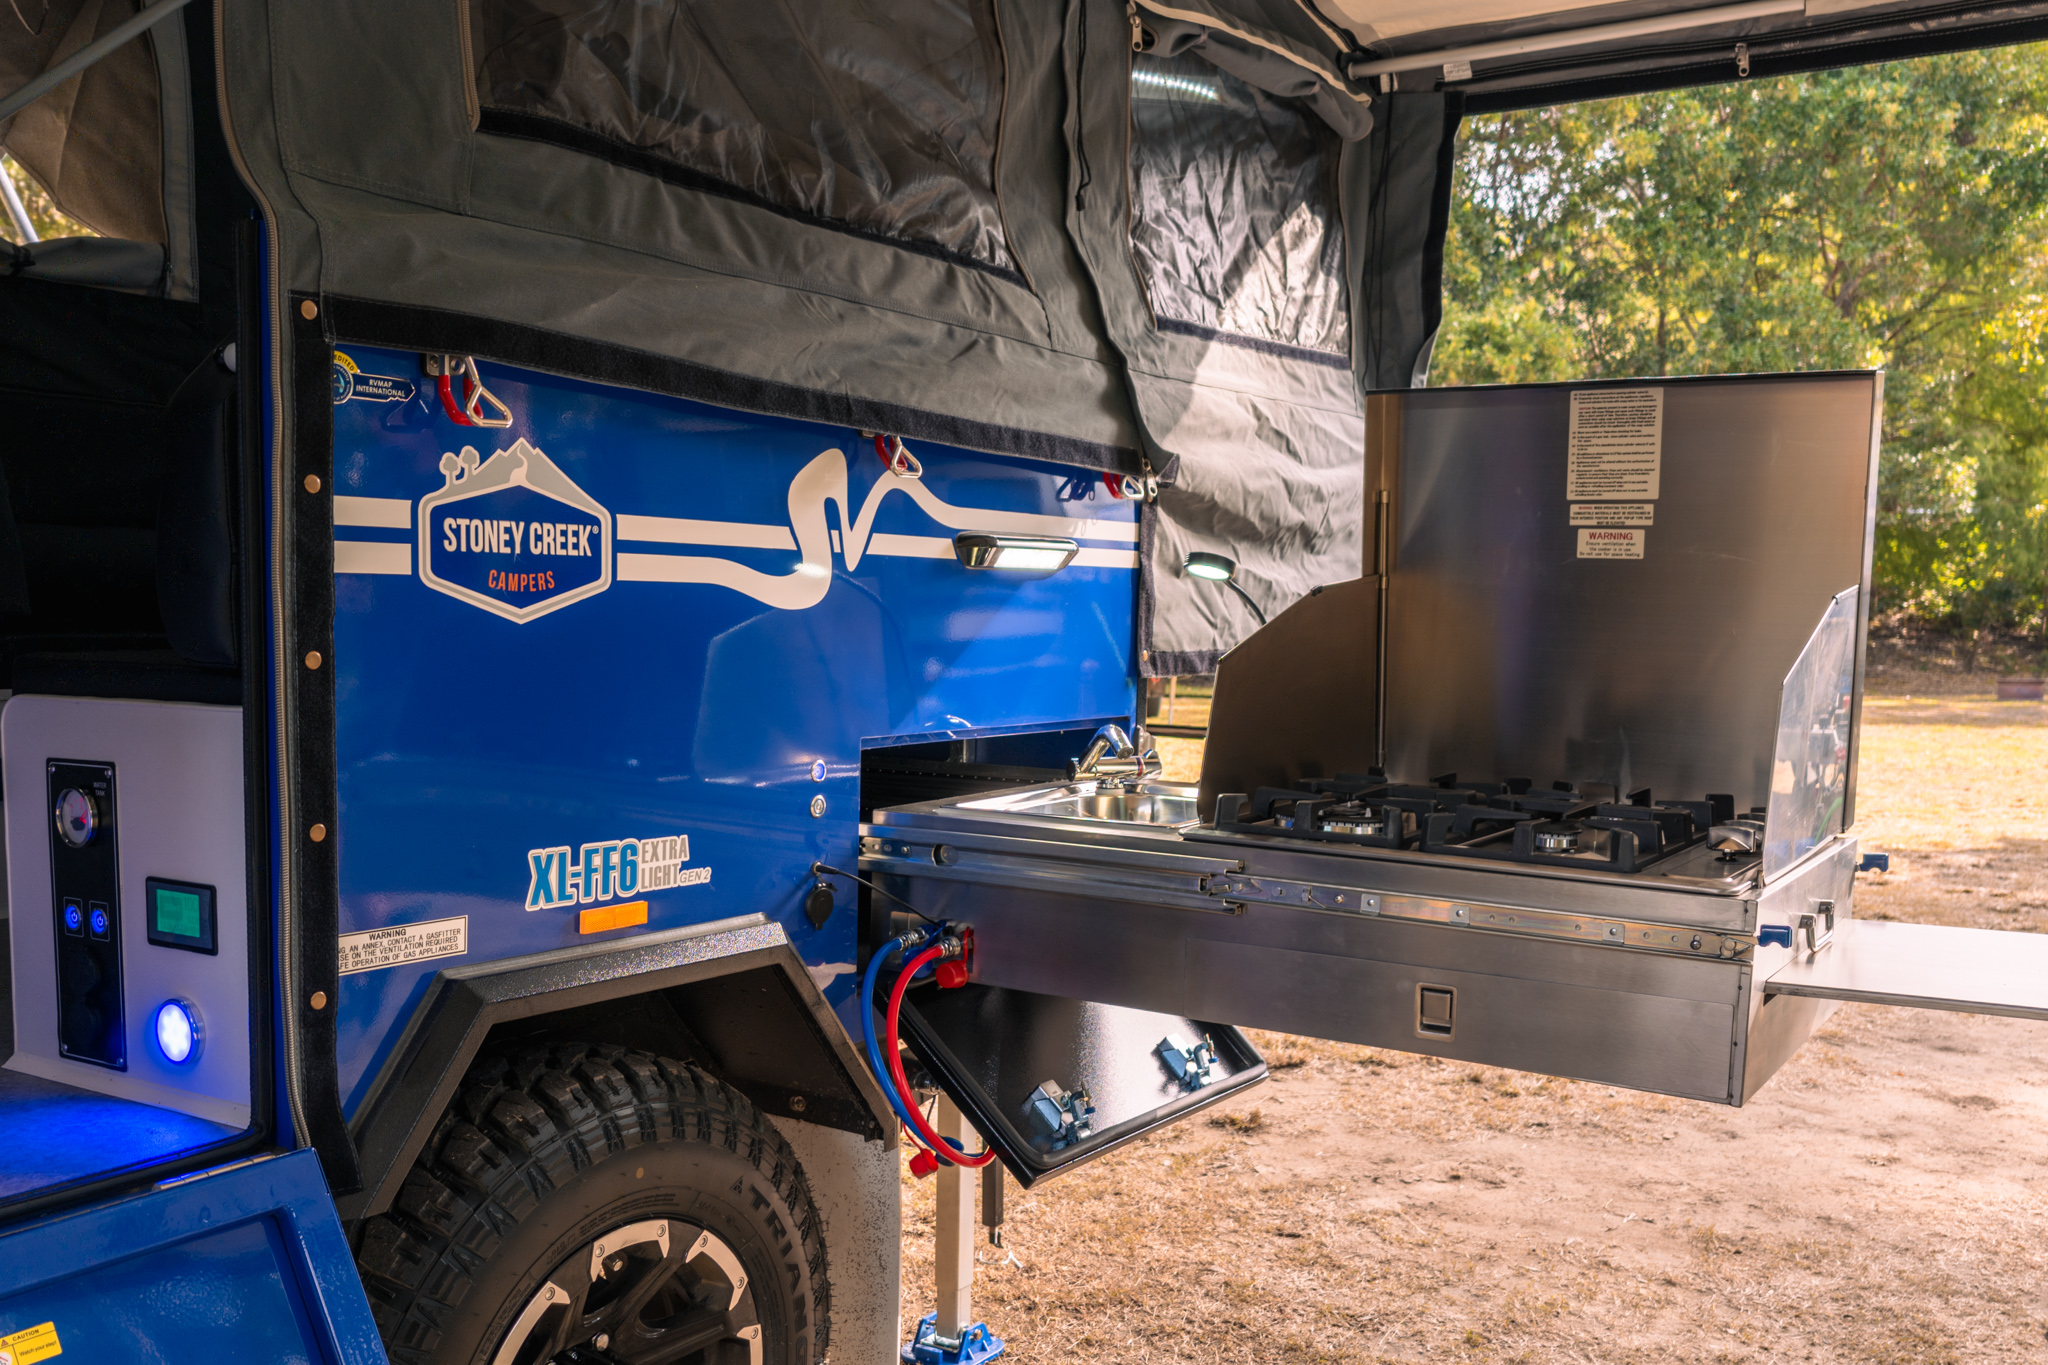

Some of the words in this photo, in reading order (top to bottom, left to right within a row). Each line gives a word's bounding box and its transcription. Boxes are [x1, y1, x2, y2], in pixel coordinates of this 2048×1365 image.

[356, 384, 406, 397] INTERNATIONAL
[368, 379, 393, 388] RVMAP
[443, 517, 525, 554] STONEY
[1589, 532, 1633, 540] WARNING
[488, 569, 555, 592] CAMPERS
[642, 837, 688, 864] EXTRA
[528, 841, 640, 908] XL-FF6
[641, 863, 680, 890] LIGHT
[680, 870, 702, 884] GEN
[703, 868, 711, 881] 2
[369, 929, 406, 941] WARNING
[387, 936, 416, 946] CONTACT
[426, 928, 461, 939] GASFITTER
[380, 941, 423, 955] VENTILATION
[426, 936, 458, 947] REQUIRED
[352, 955, 390, 967] OPERATION
[418, 943, 459, 956] APPLIANCES
[12, 1329, 39, 1341] CAUTION
[19, 1348, 34, 1356] Watch
